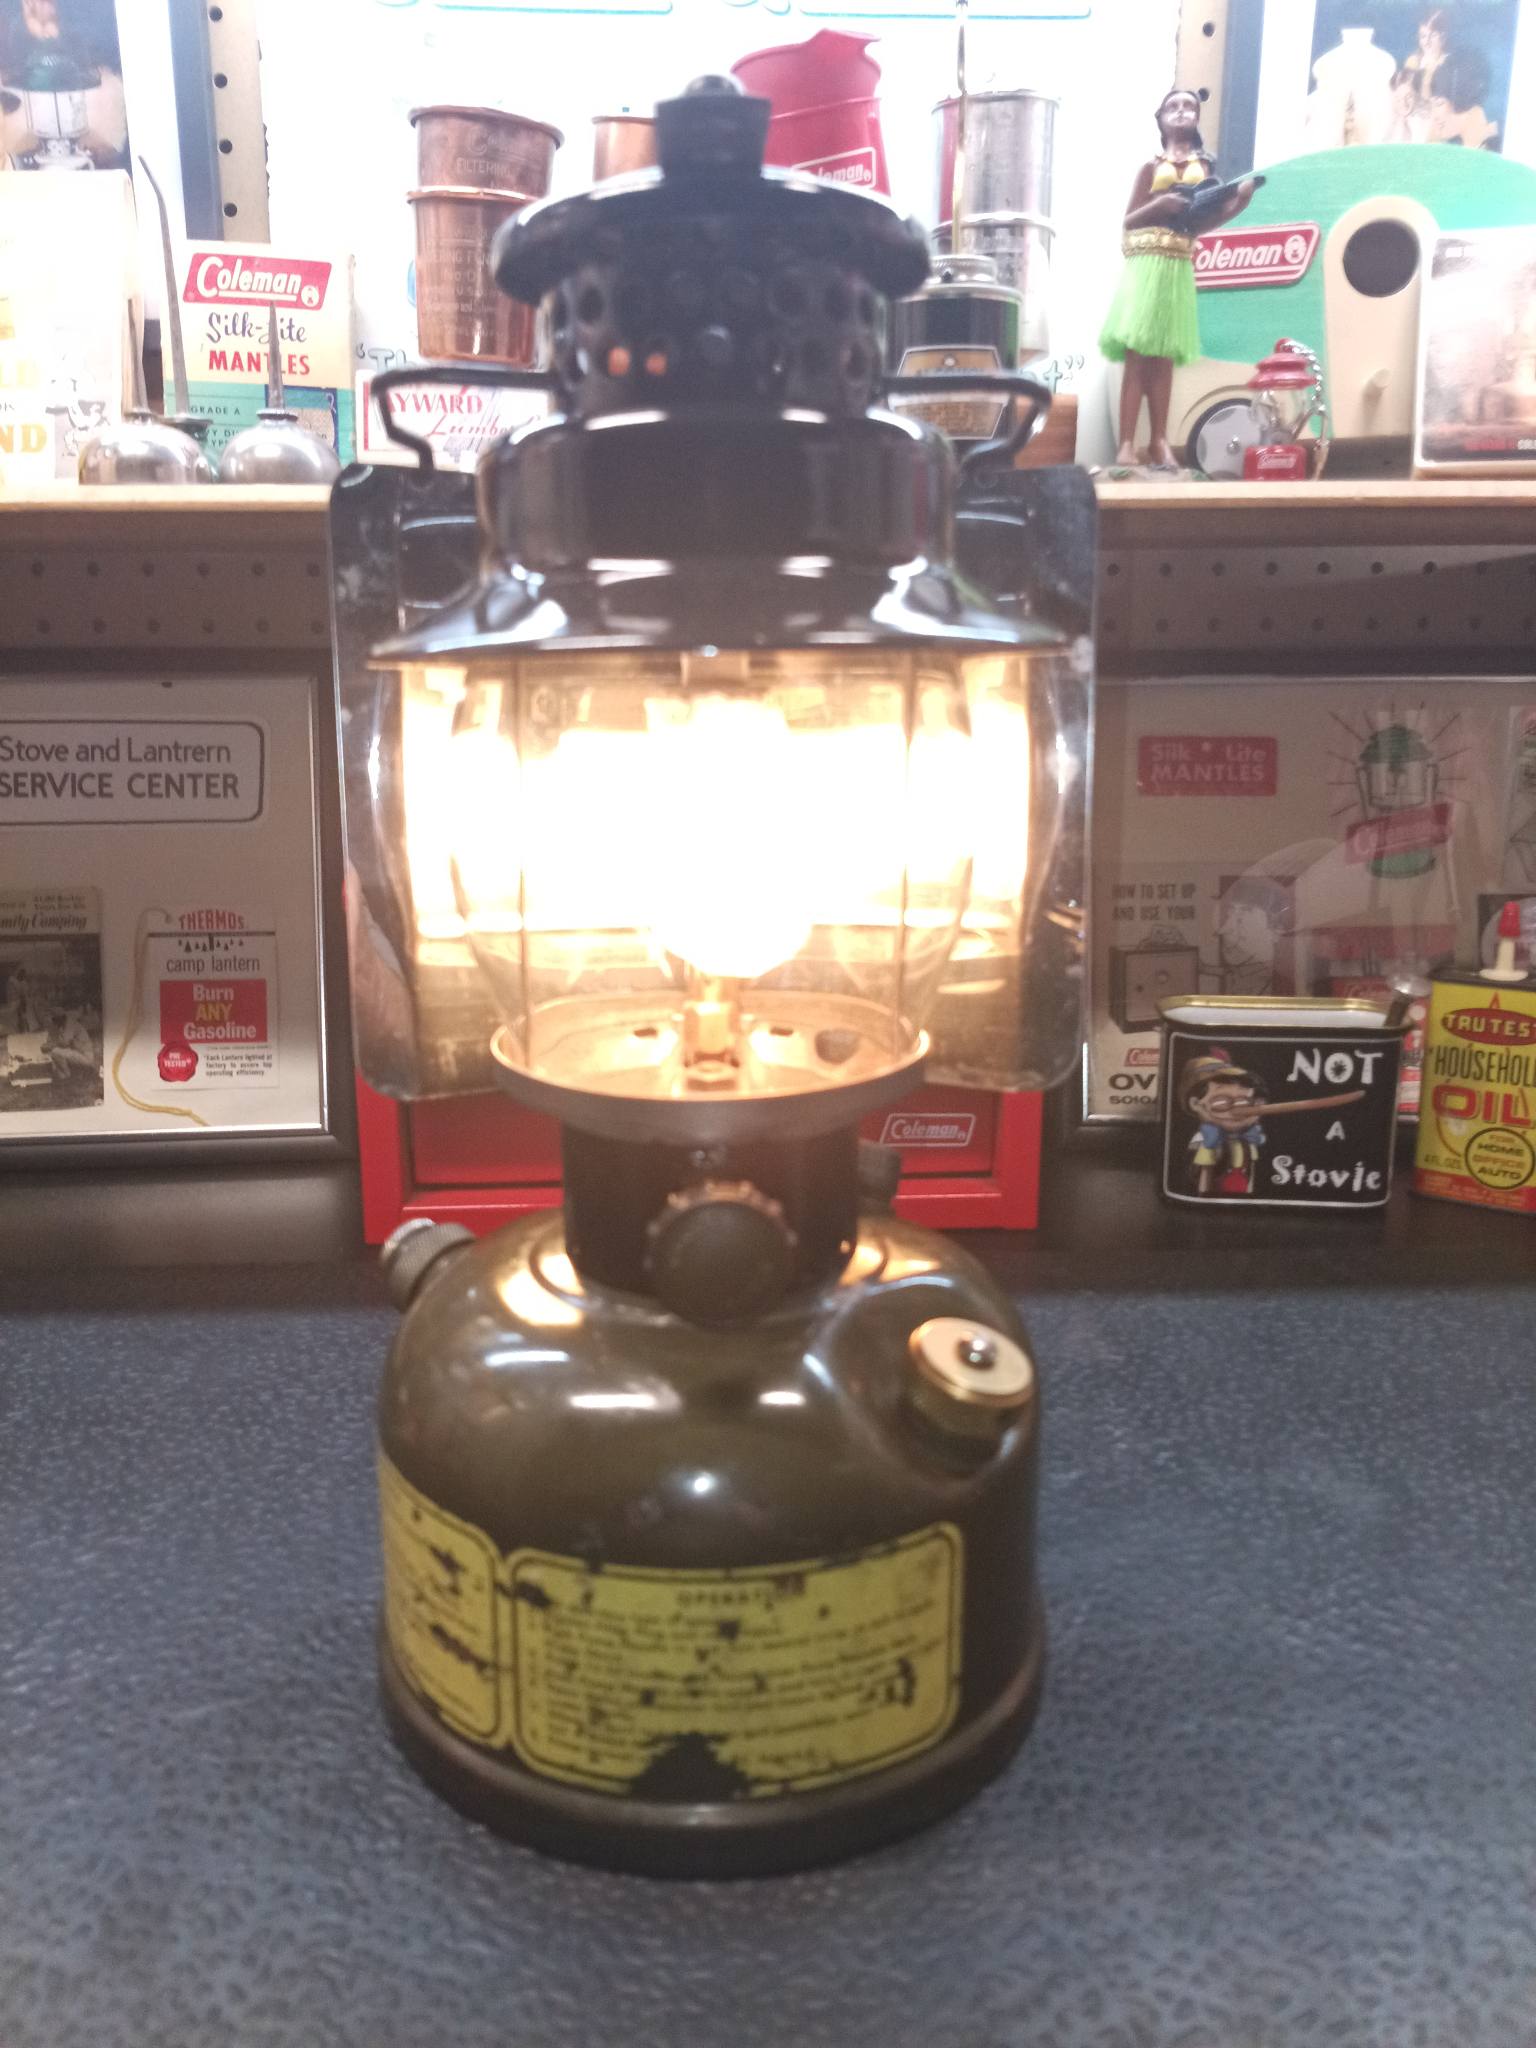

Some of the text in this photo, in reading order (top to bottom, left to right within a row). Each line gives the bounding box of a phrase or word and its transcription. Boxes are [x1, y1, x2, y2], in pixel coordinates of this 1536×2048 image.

[196, 256, 301, 300] Coleman
[0, 736, 231, 763] Stove and Lantrern
[1151, 742, 1267, 763] Silk Lite
[1151, 763, 1266, 783] MANTLES
[0, 772, 239, 799] SERVICE CENTER
[178, 909, 246, 931] THERMOS
[166, 955, 261, 974] camp lantern
[192, 983, 234, 1001] Burn
[195, 1003, 232, 1022] ANY
[183, 1021, 257, 1041] Gasoline
[1286, 1048, 1384, 1084] NOT
[1432, 1083, 1533, 1131] OIL
[890, 1118, 960, 1139] Coleman
[1325, 1120, 1346, 1140] A
[1478, 1142, 1525, 1157] HOME
[1477, 1167, 1523, 1181] AUTO
